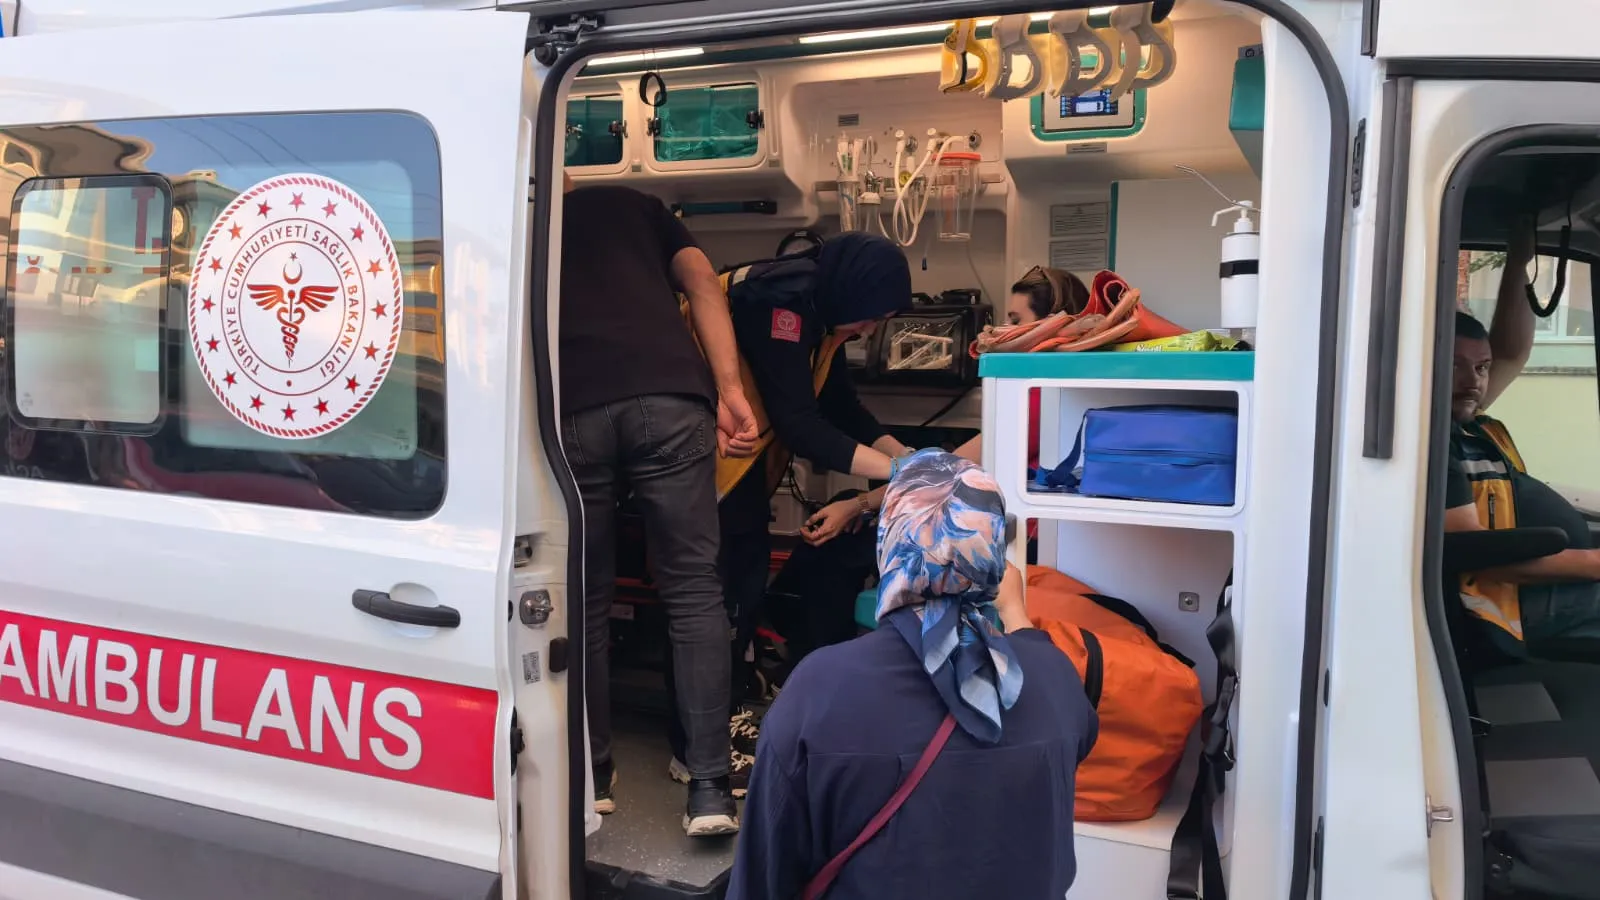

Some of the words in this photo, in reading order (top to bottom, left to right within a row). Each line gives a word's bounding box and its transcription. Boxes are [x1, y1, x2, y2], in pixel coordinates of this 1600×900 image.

[227, 223, 309, 300] CUMHURİYETİ
[311, 230, 355, 280] SAĞLIK
[226, 306, 260, 376] TÜRKİYE
[319, 284, 359, 378] BAKANLIĞI
[0, 623, 423, 771] AMBULANS
